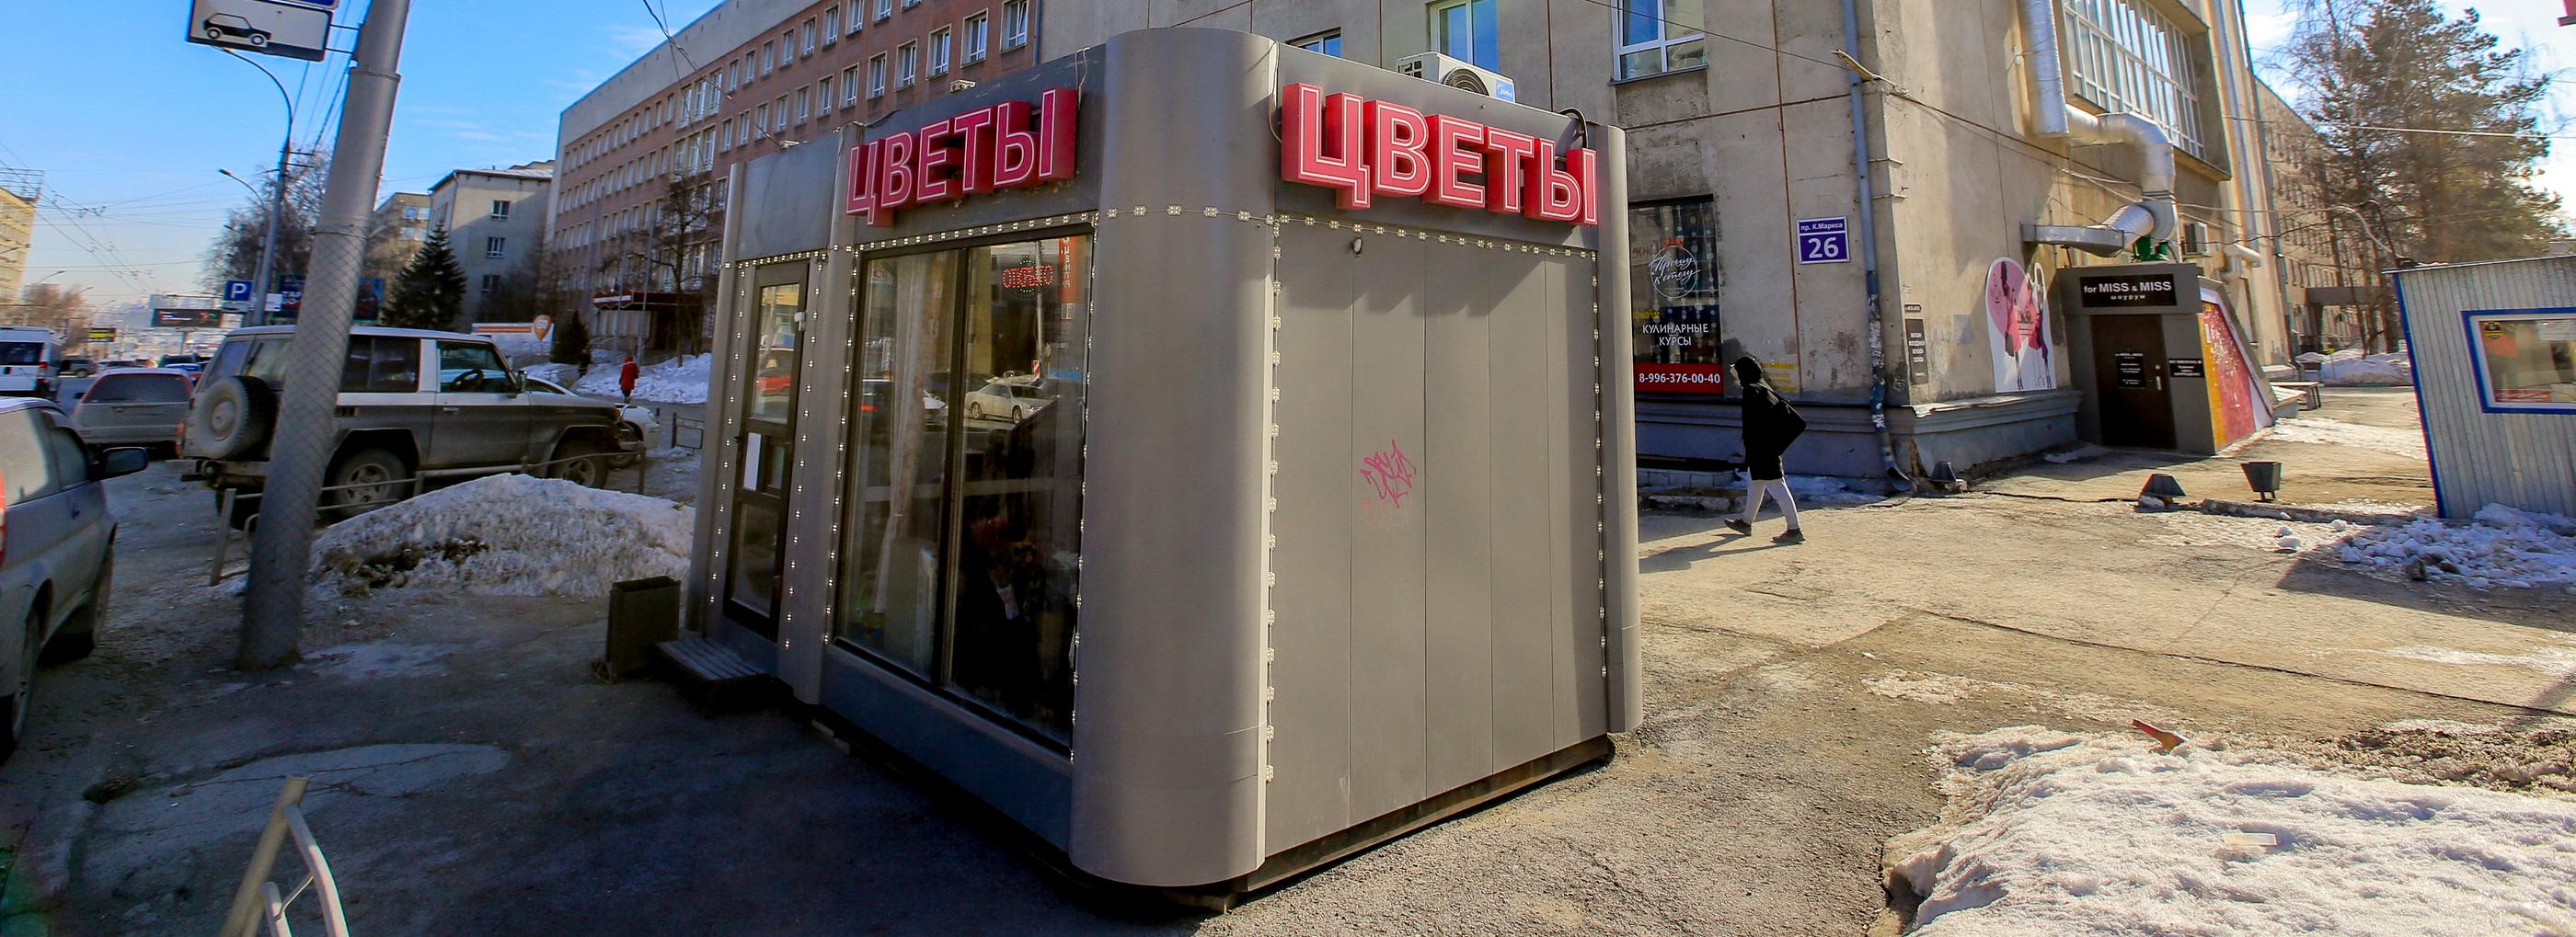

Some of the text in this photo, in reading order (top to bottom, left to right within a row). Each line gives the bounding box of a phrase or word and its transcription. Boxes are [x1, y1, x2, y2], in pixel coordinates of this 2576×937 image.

[846, 88, 1076, 226] ЦВЕТЫ
[1282, 83, 1598, 225] ЦВЕТЫ
[1808, 236, 1839, 258] 26
[231, 283, 247, 300] P
[2099, 282, 2129, 292] MISS
[2139, 281, 2171, 291] MISS
[1642, 324, 1708, 334] КУЛИНАРНЫЕ
[1659, 337, 1692, 346] КУРСЫ
[1639, 373, 1720, 383] 8-996-376-00-40
